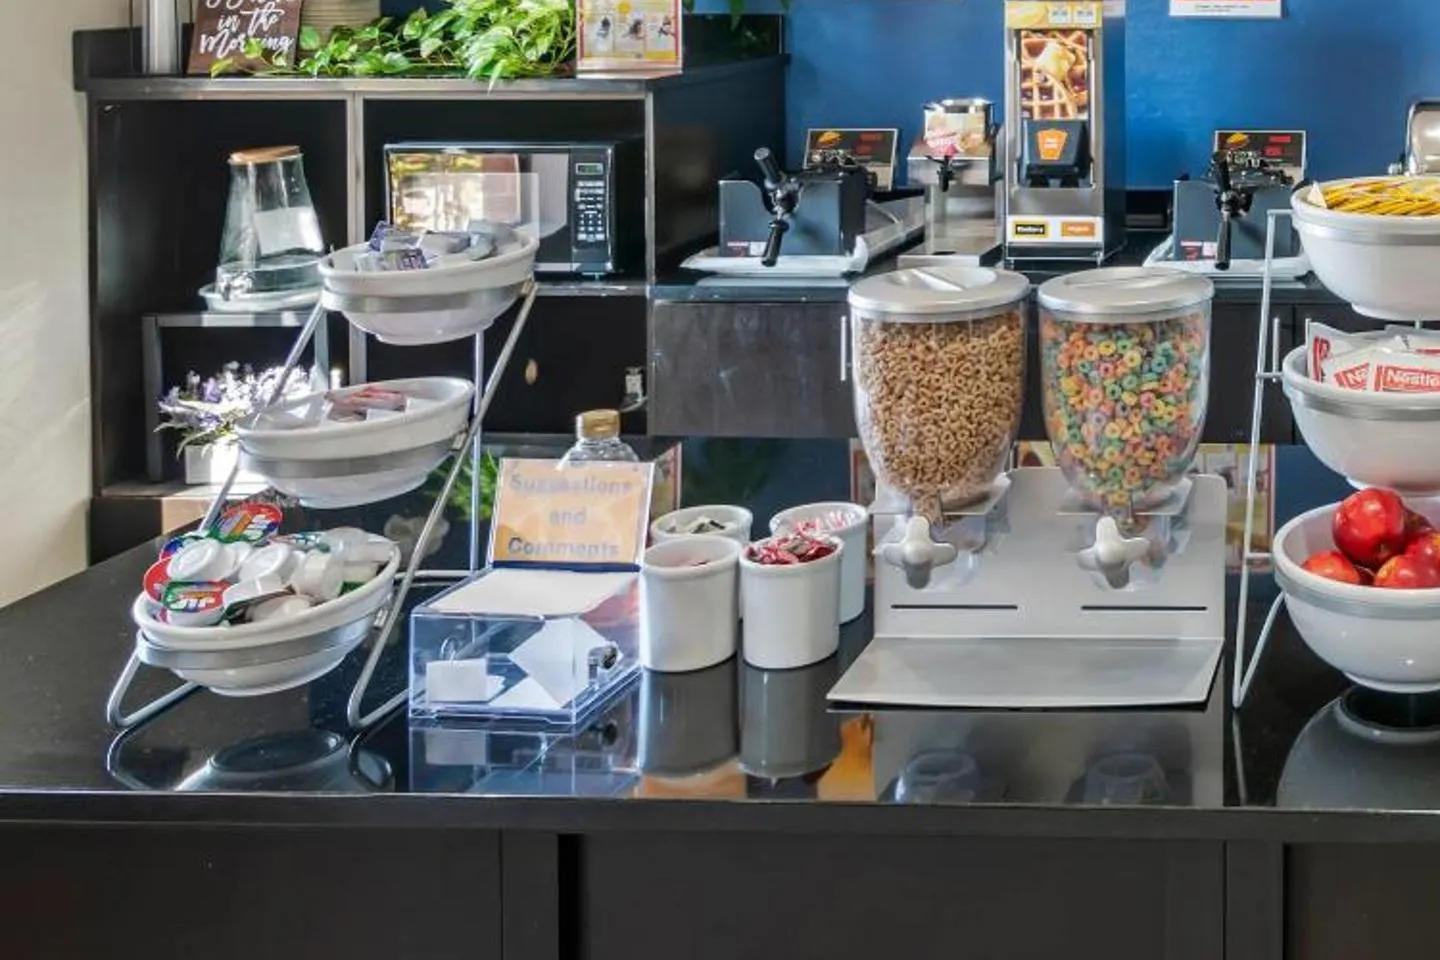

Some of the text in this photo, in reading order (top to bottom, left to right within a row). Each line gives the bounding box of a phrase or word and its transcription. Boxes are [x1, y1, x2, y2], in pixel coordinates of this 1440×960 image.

[216, 1, 286, 36] in the
[199, 28, 294, 62] Moring
[507, 536, 620, 558] Comments
